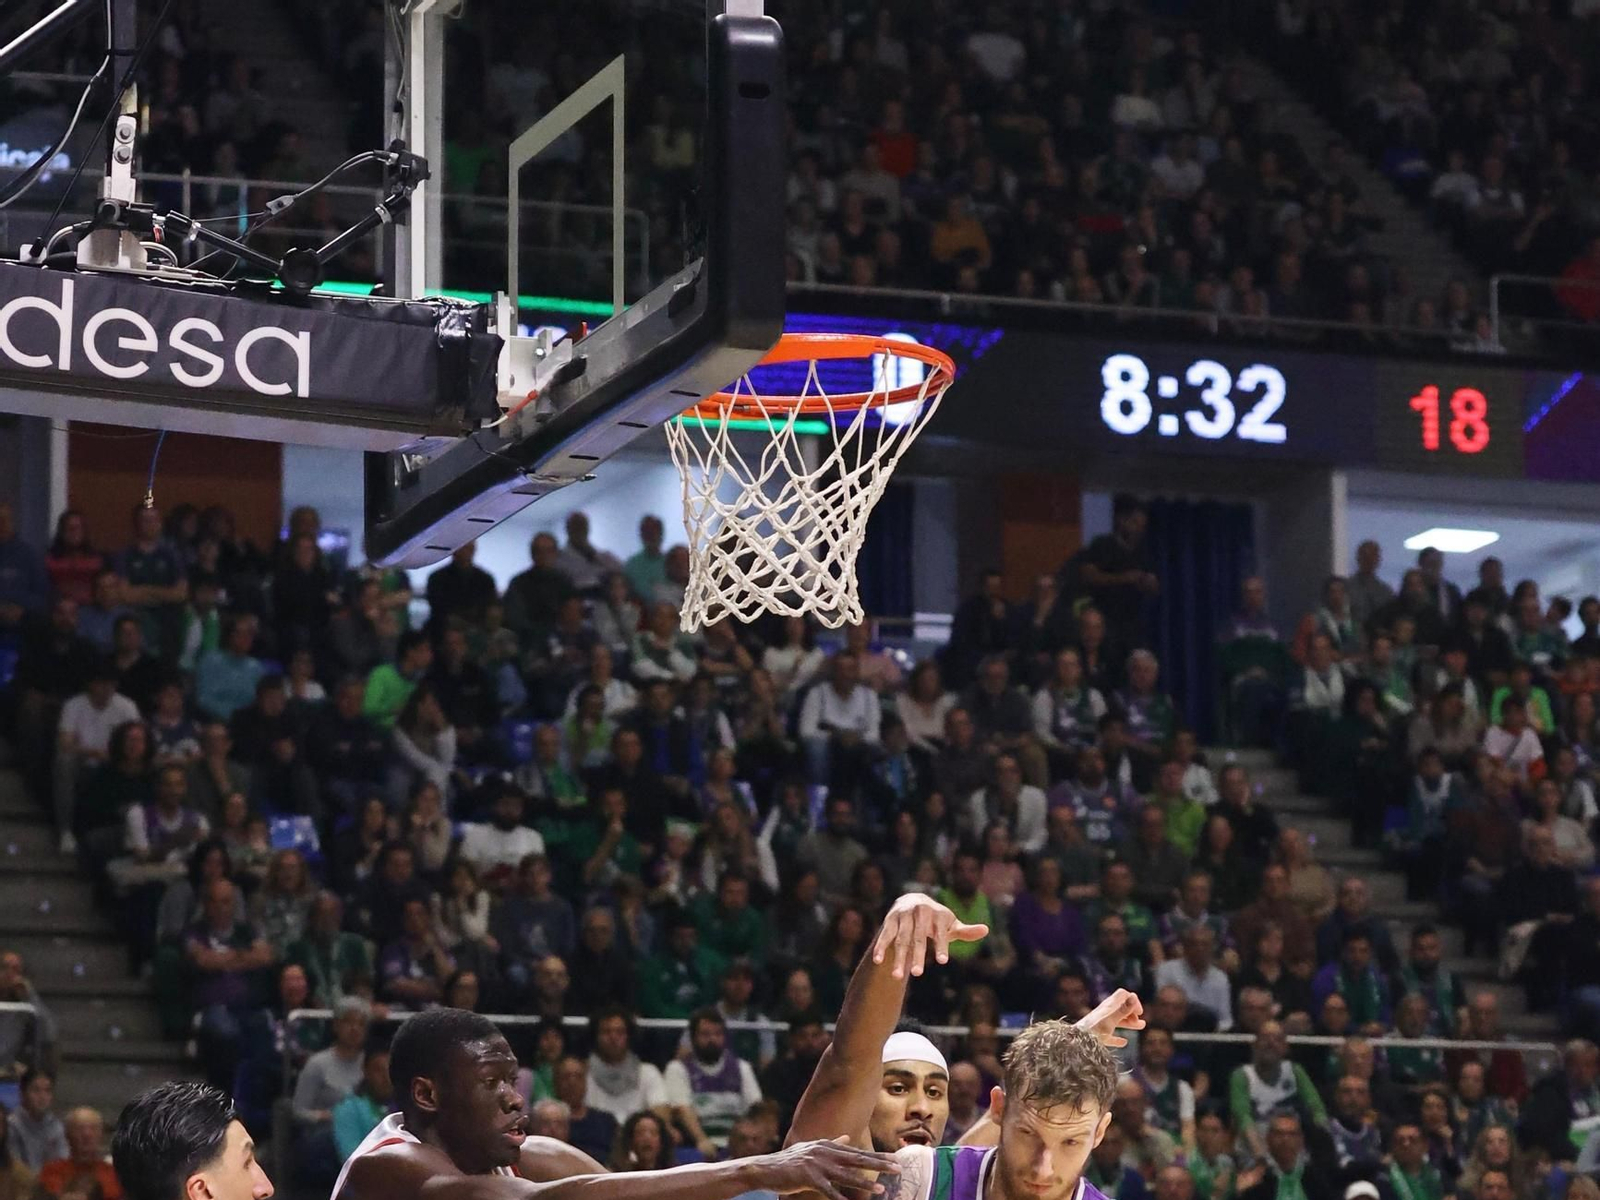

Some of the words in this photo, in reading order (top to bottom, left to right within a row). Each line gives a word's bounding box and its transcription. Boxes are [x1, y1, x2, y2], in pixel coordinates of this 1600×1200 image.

[0, 278, 311, 398] desa
[1100, 353, 1287, 443] 8:32
[1409, 384, 1490, 453] 18
